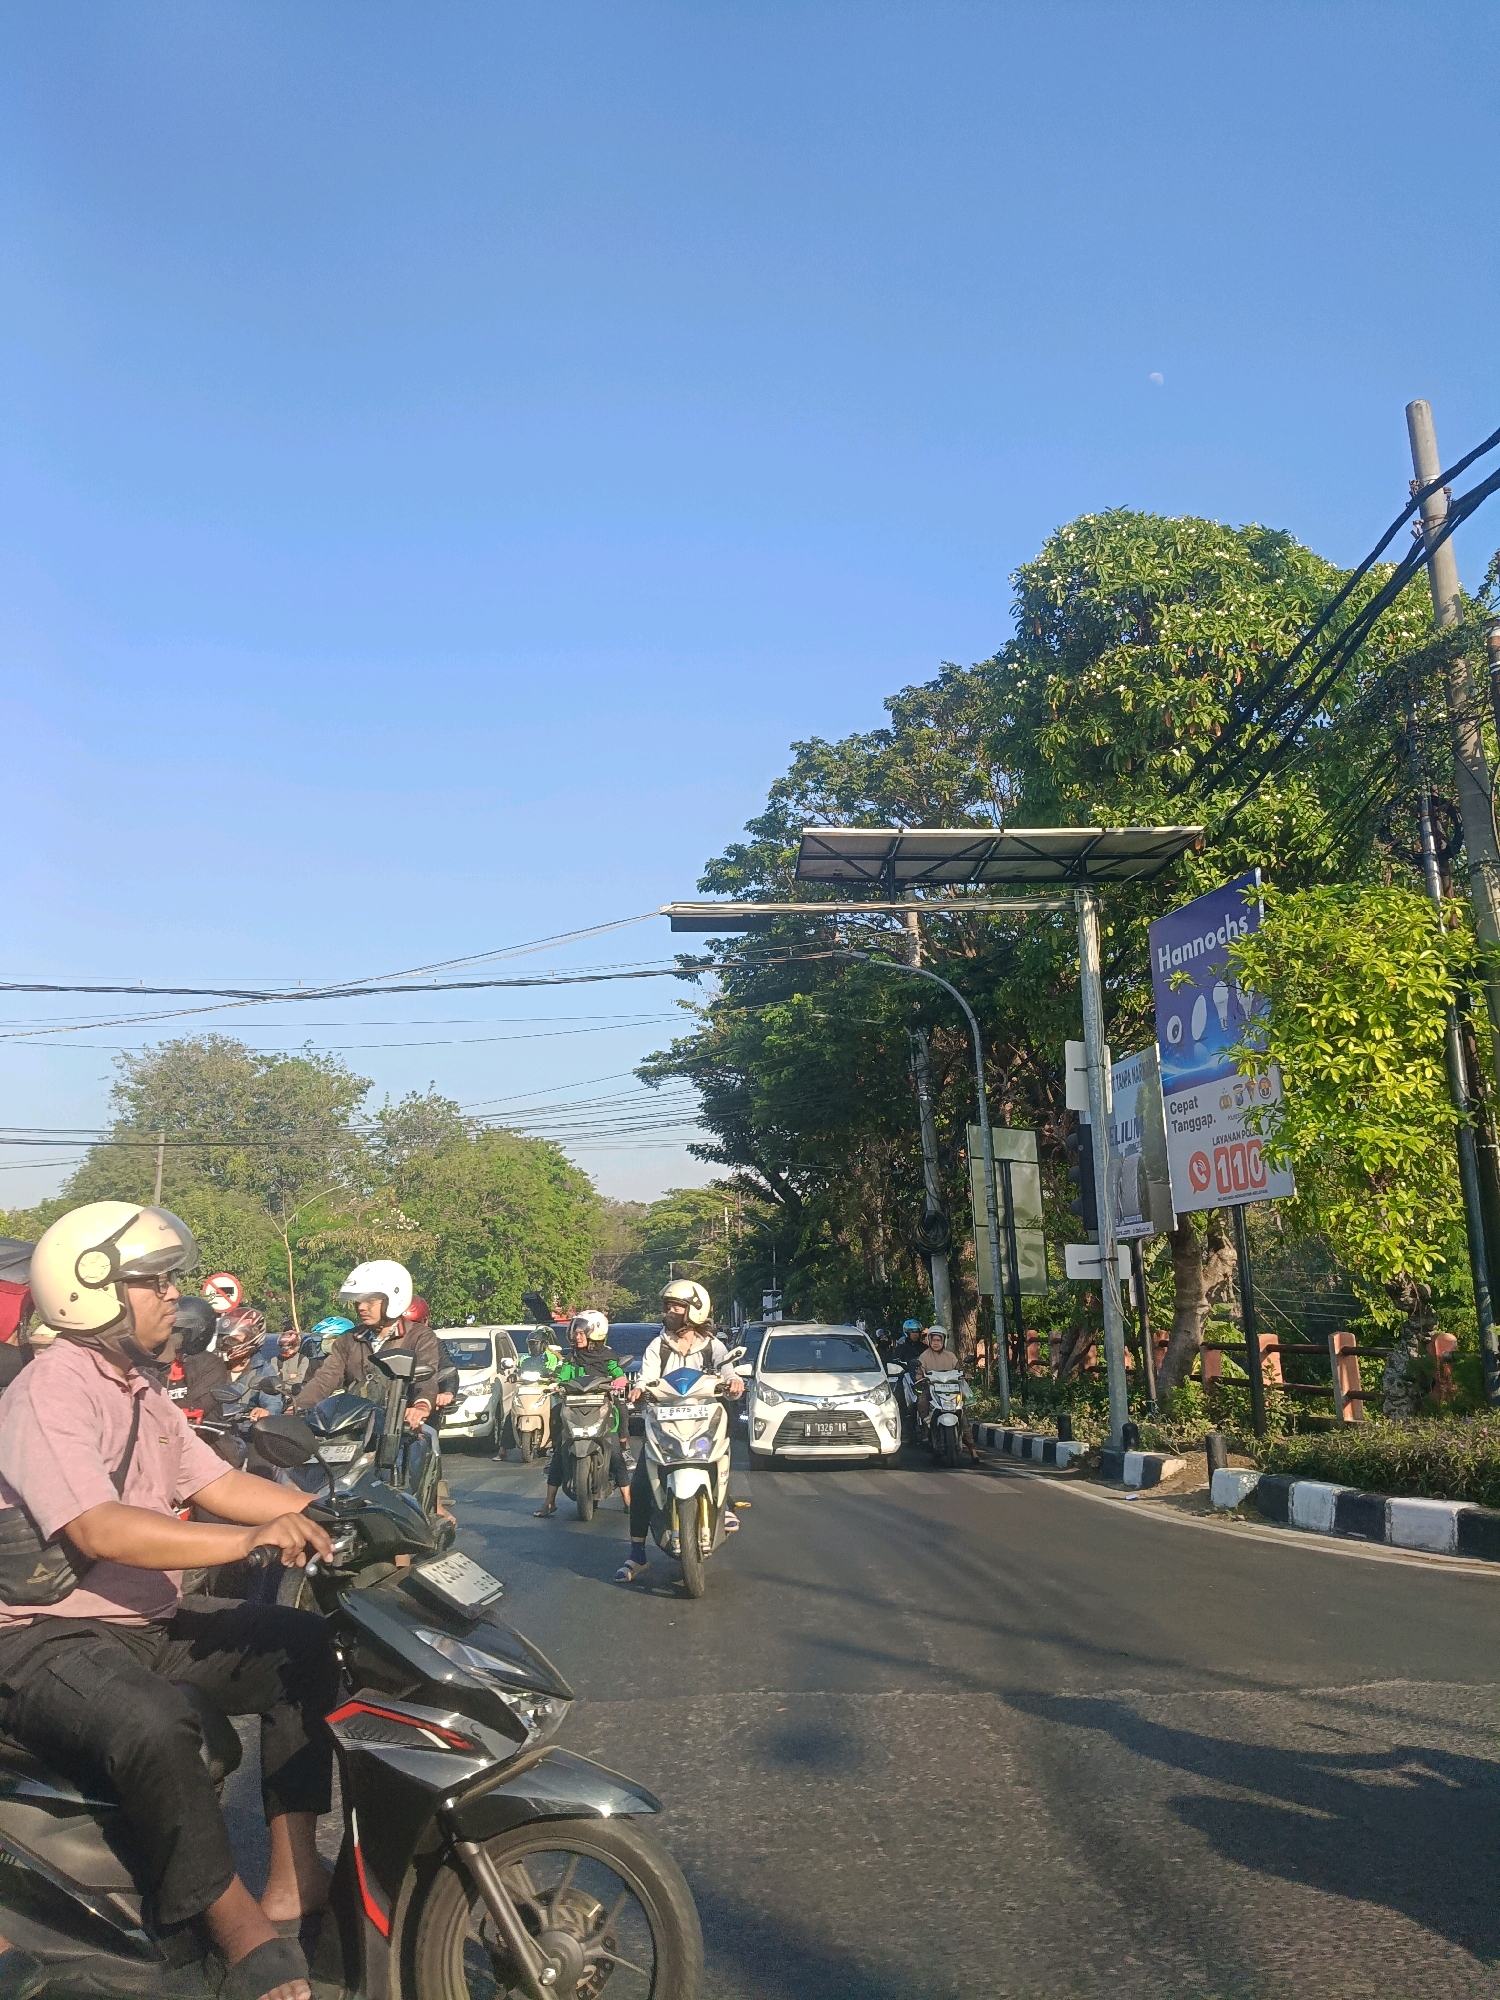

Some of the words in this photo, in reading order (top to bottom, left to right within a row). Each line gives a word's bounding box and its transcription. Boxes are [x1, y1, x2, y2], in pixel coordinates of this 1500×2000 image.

[1158, 914, 1248, 972] Hannochs
[1170, 1096, 1199, 1115] Cepat
[1171, 1113, 1216, 1133] Tanggap.
[1212, 1130, 1241, 1146] LAYANAN
[1218, 1147, 1263, 1188] 110
[817, 1423, 833, 1432] 1326
